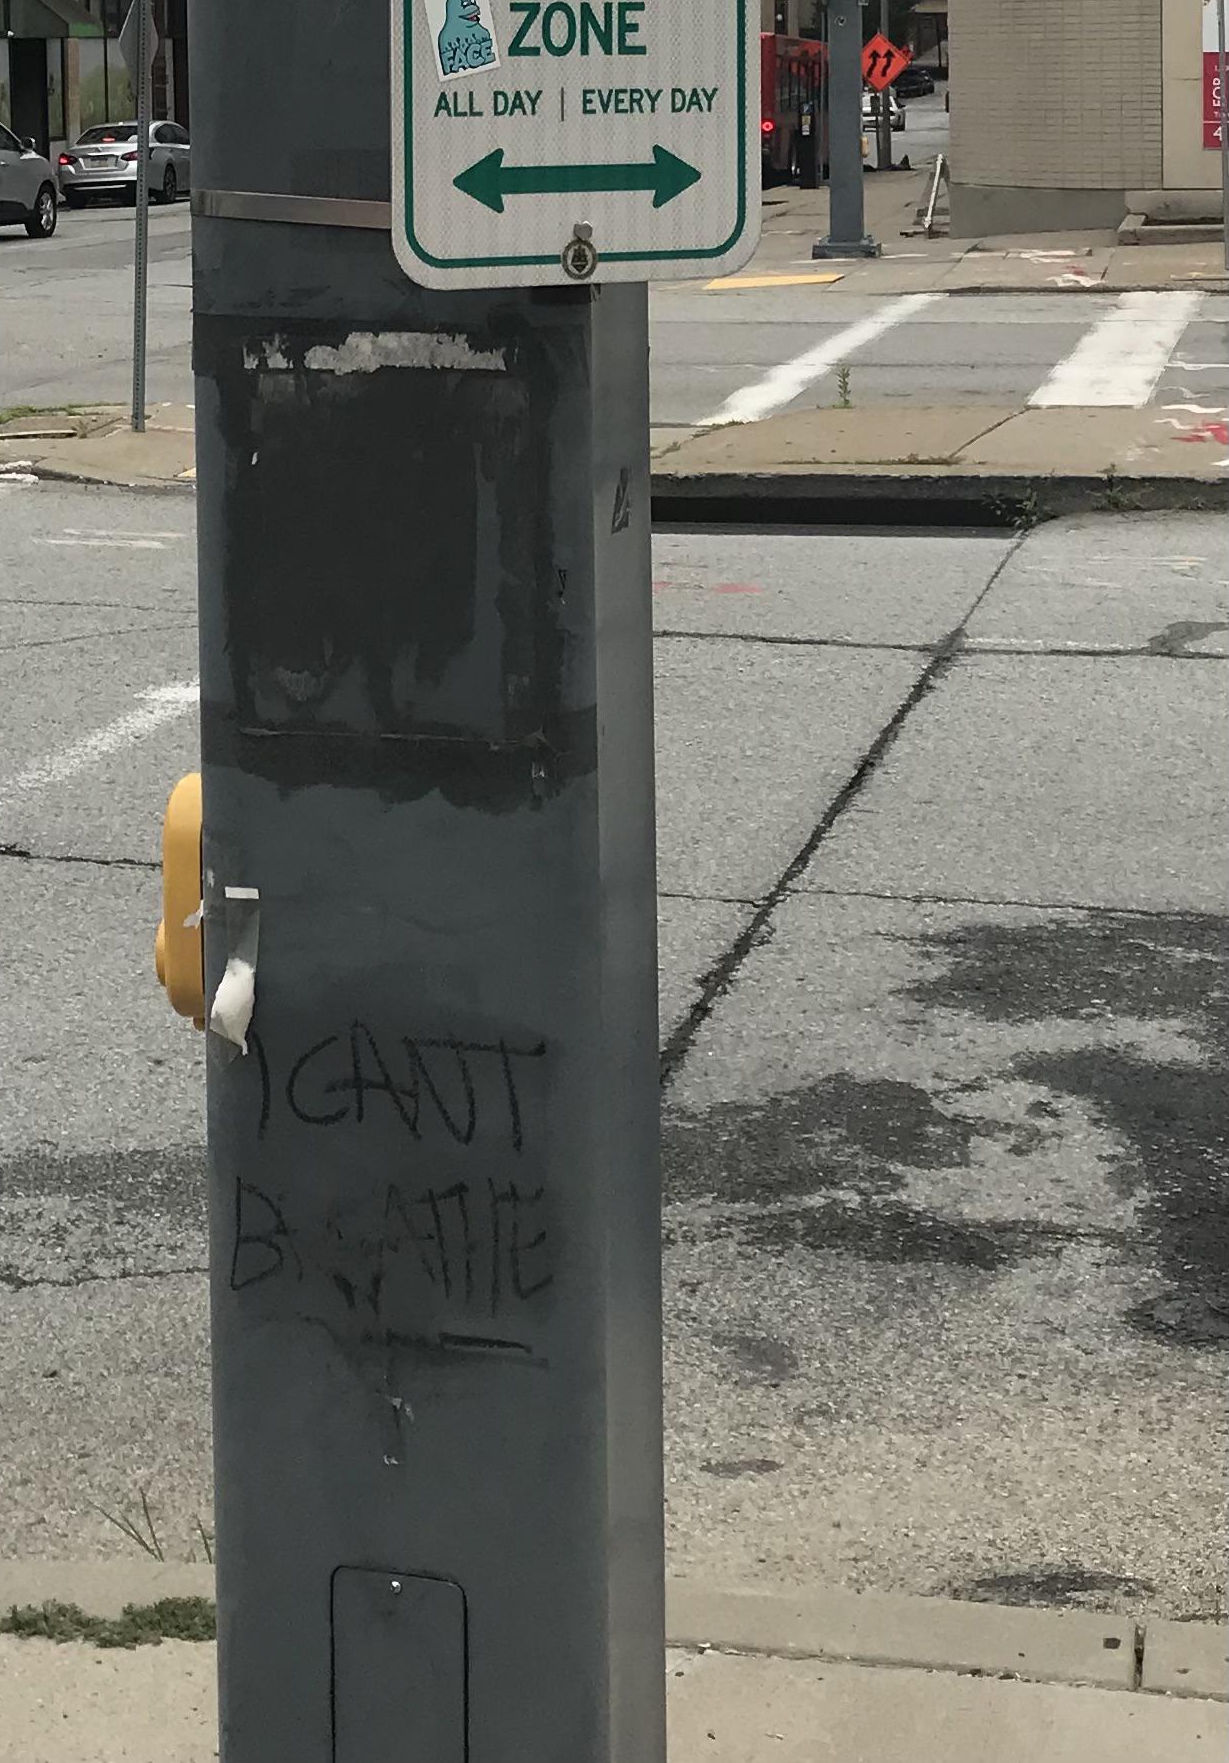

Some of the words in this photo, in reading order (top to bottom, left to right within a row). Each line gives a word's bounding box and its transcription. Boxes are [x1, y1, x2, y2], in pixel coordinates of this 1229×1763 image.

[507, 1, 647, 57] ZONE
[441, 39, 496, 75] FACE
[433, 89, 483, 117] ALL
[493, 89, 543, 116] DAY
[582, 87, 663, 115] EVERY
[670, 87, 719, 113] DAY
